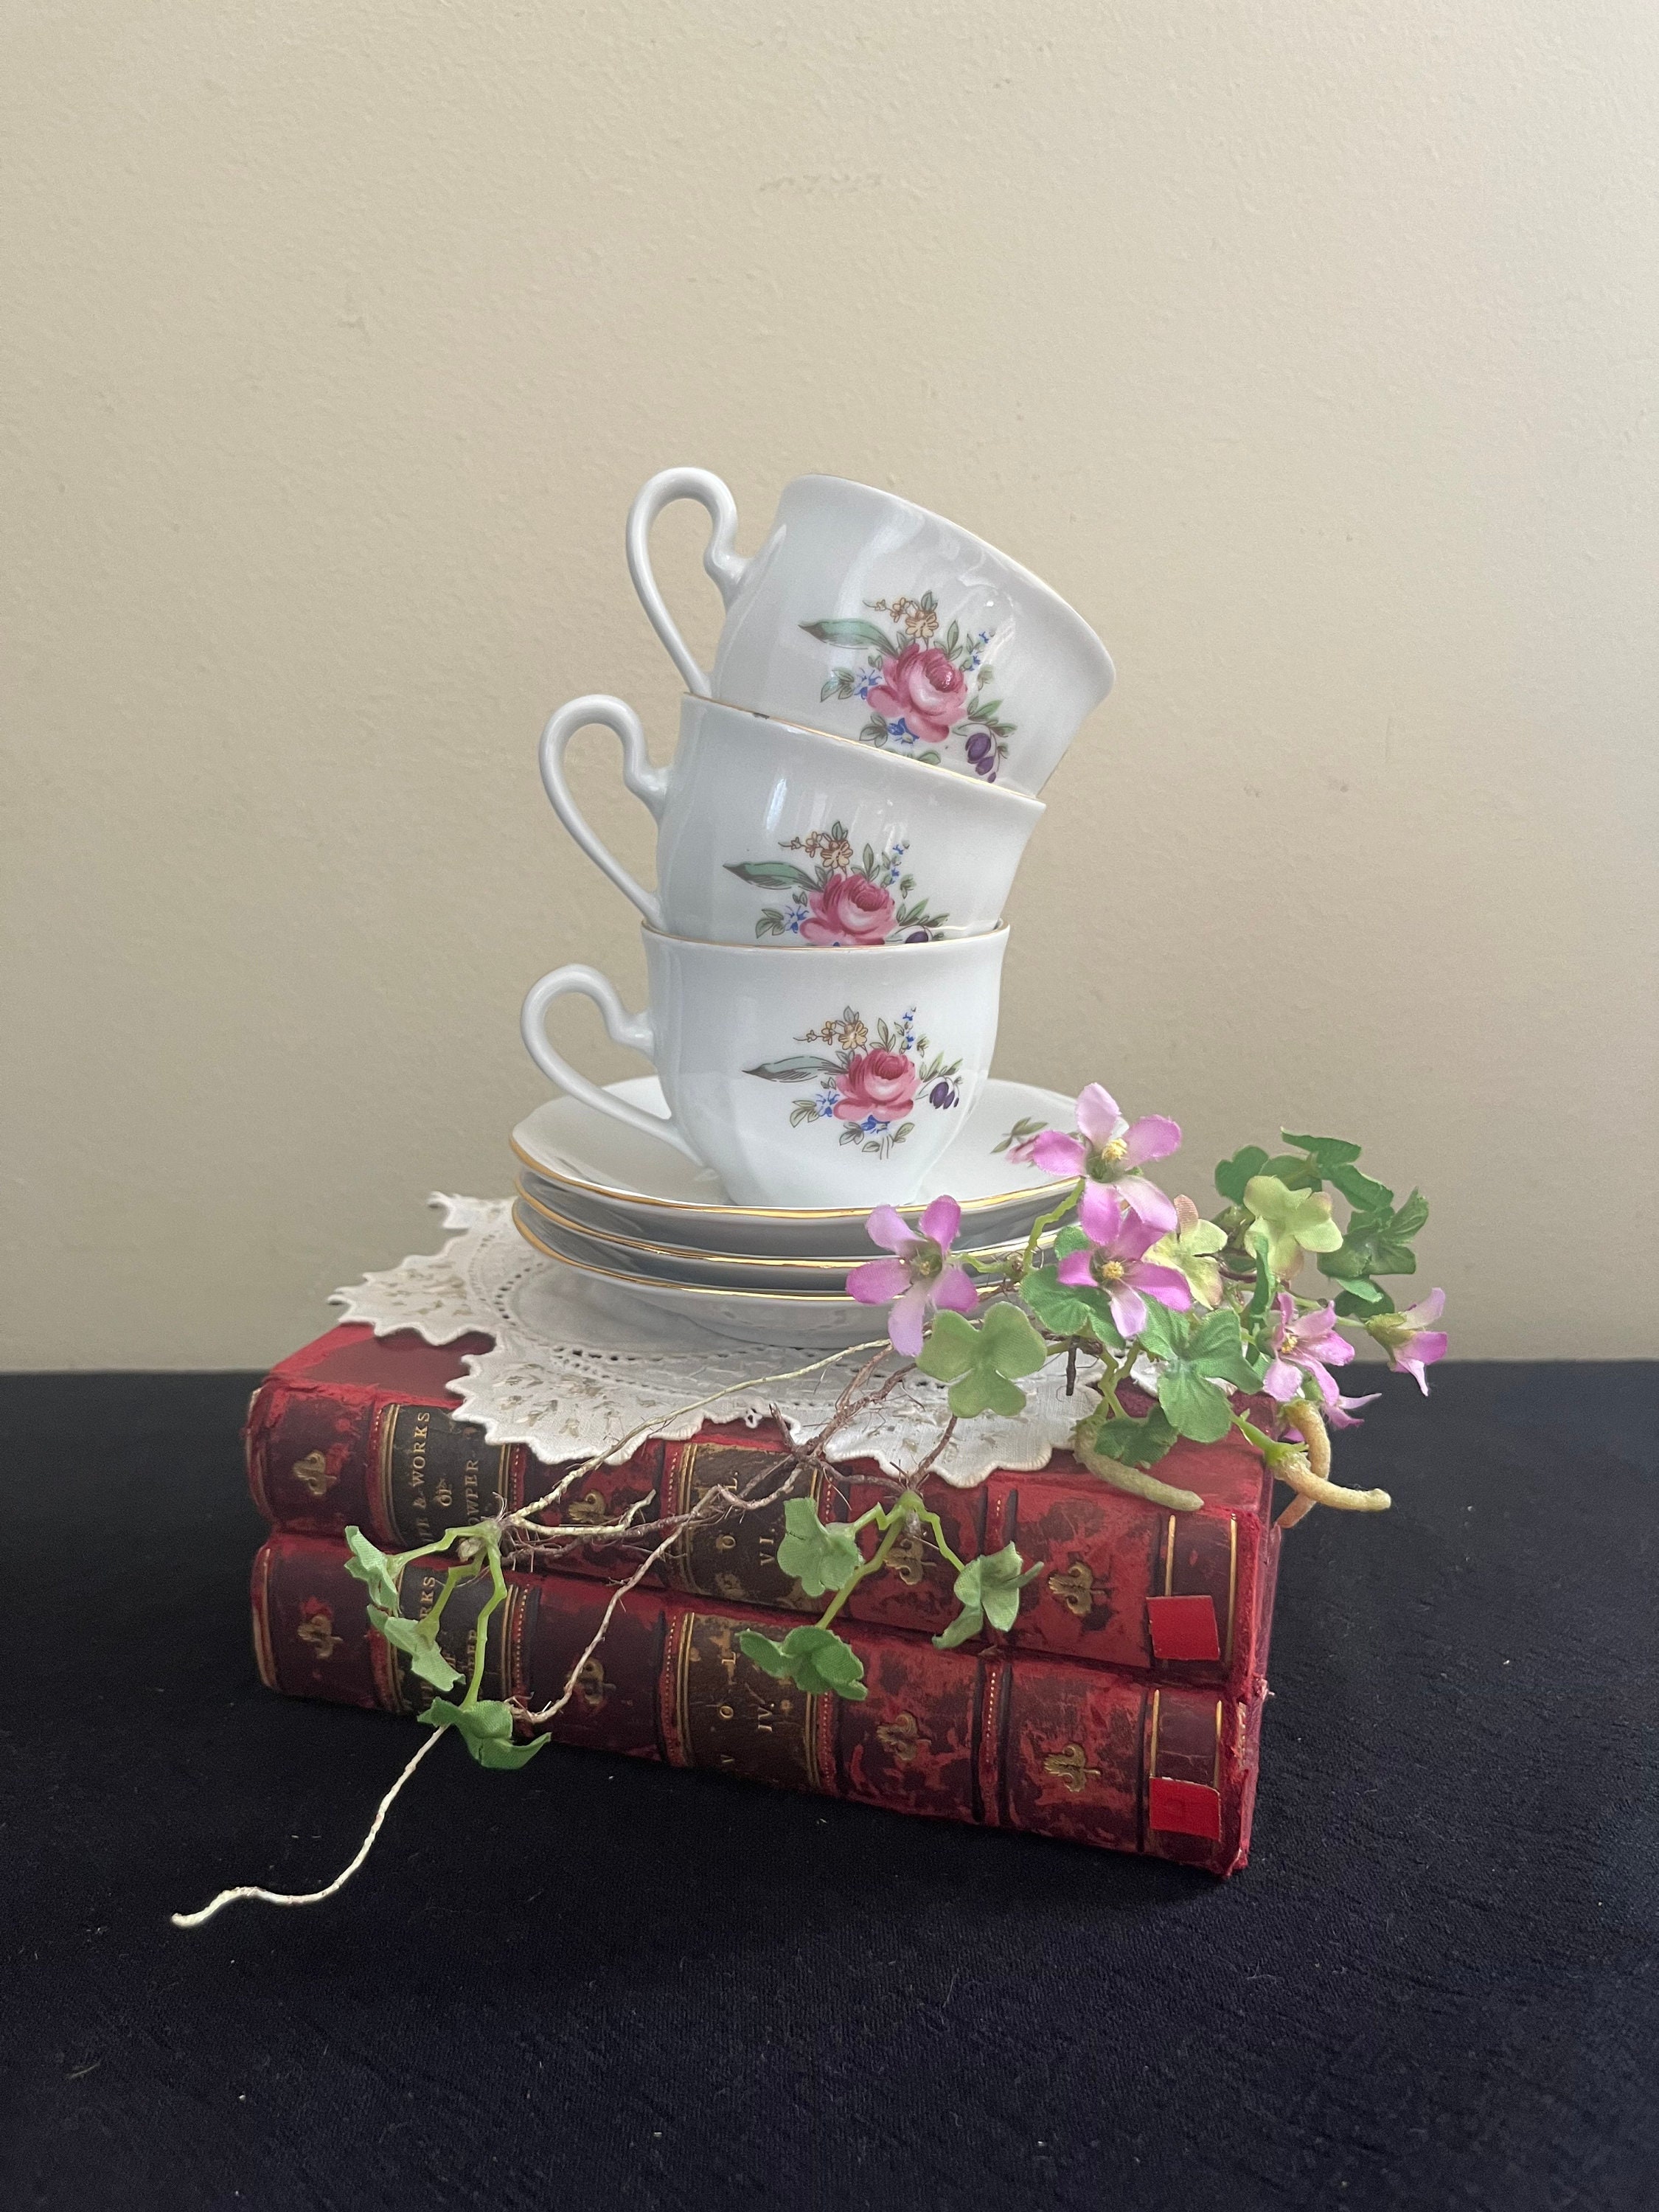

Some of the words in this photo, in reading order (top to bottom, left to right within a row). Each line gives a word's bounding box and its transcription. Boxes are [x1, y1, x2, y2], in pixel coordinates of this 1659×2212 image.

[411, 1411, 430, 1486] WORKS
[464, 1459, 479, 1526] OWPER
[419, 1576, 435, 1619] RKS
[757, 1703, 775, 1733] IV.
